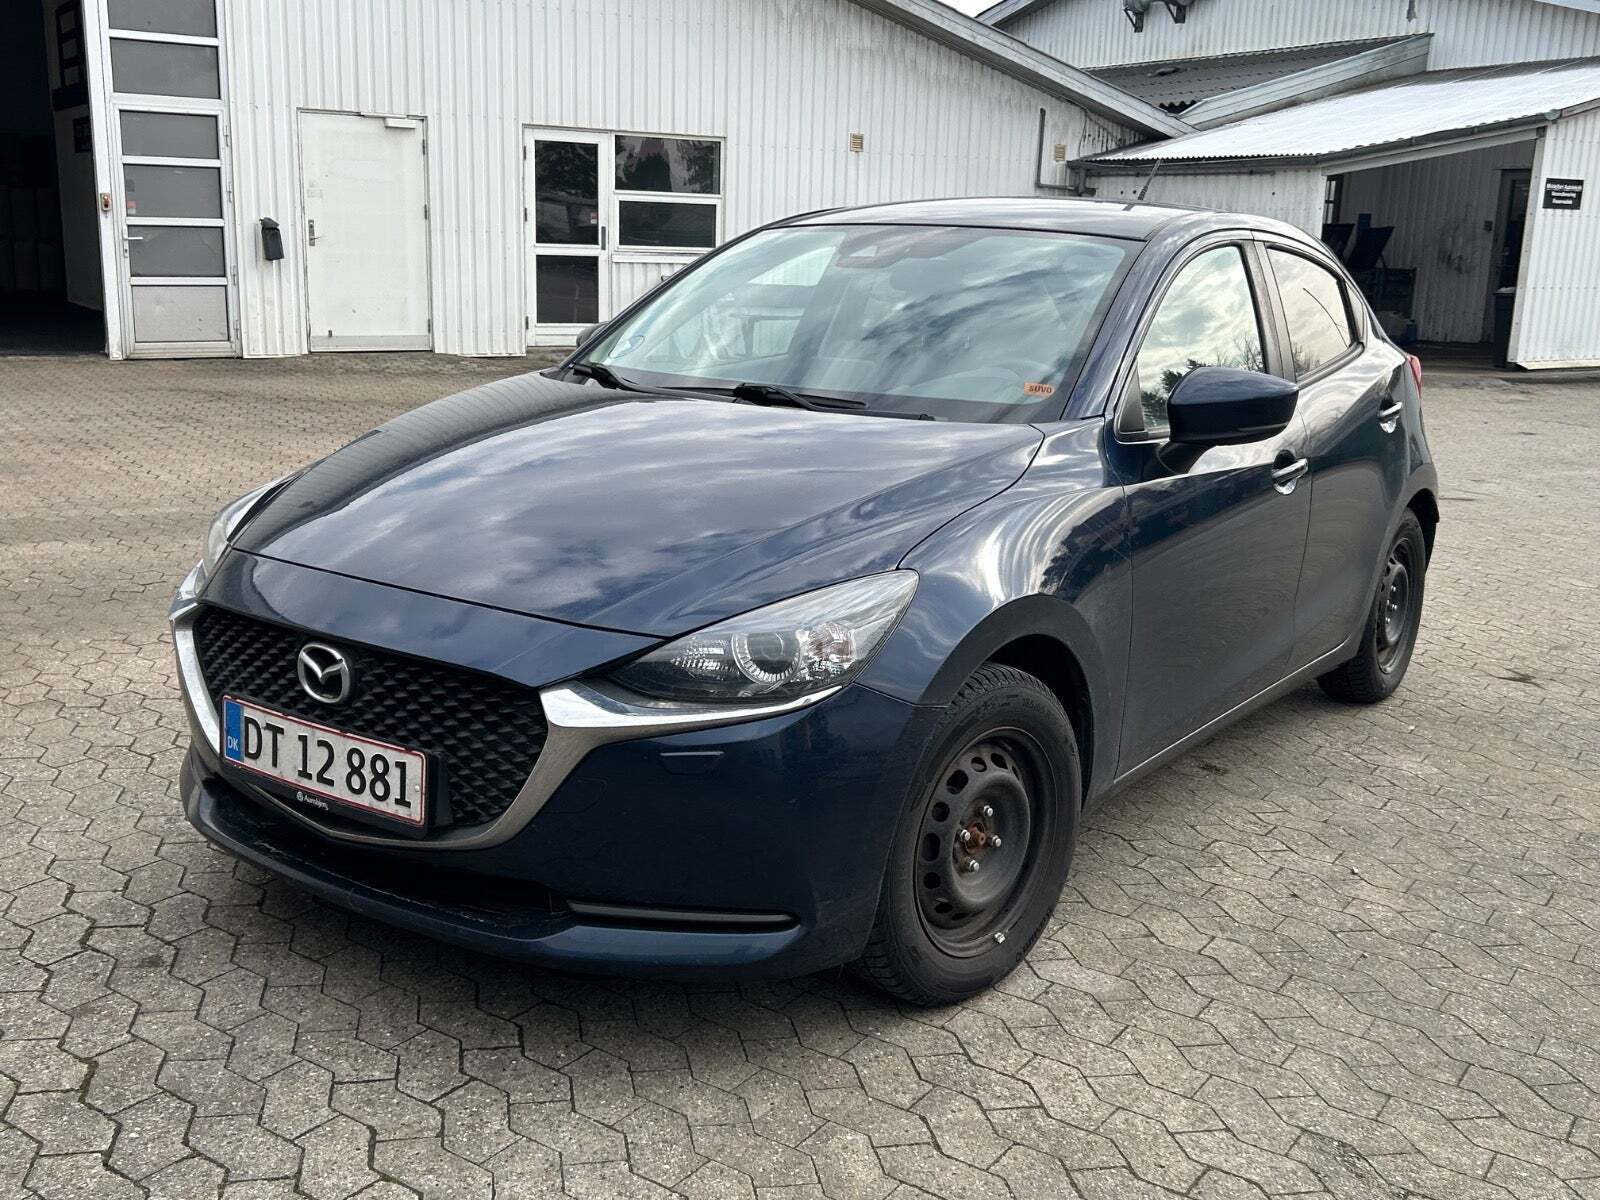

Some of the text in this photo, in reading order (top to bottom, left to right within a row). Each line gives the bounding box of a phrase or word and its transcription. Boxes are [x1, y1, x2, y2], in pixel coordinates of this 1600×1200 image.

[227, 735, 239, 751] DK
[244, 716, 411, 808] DT 12 881
